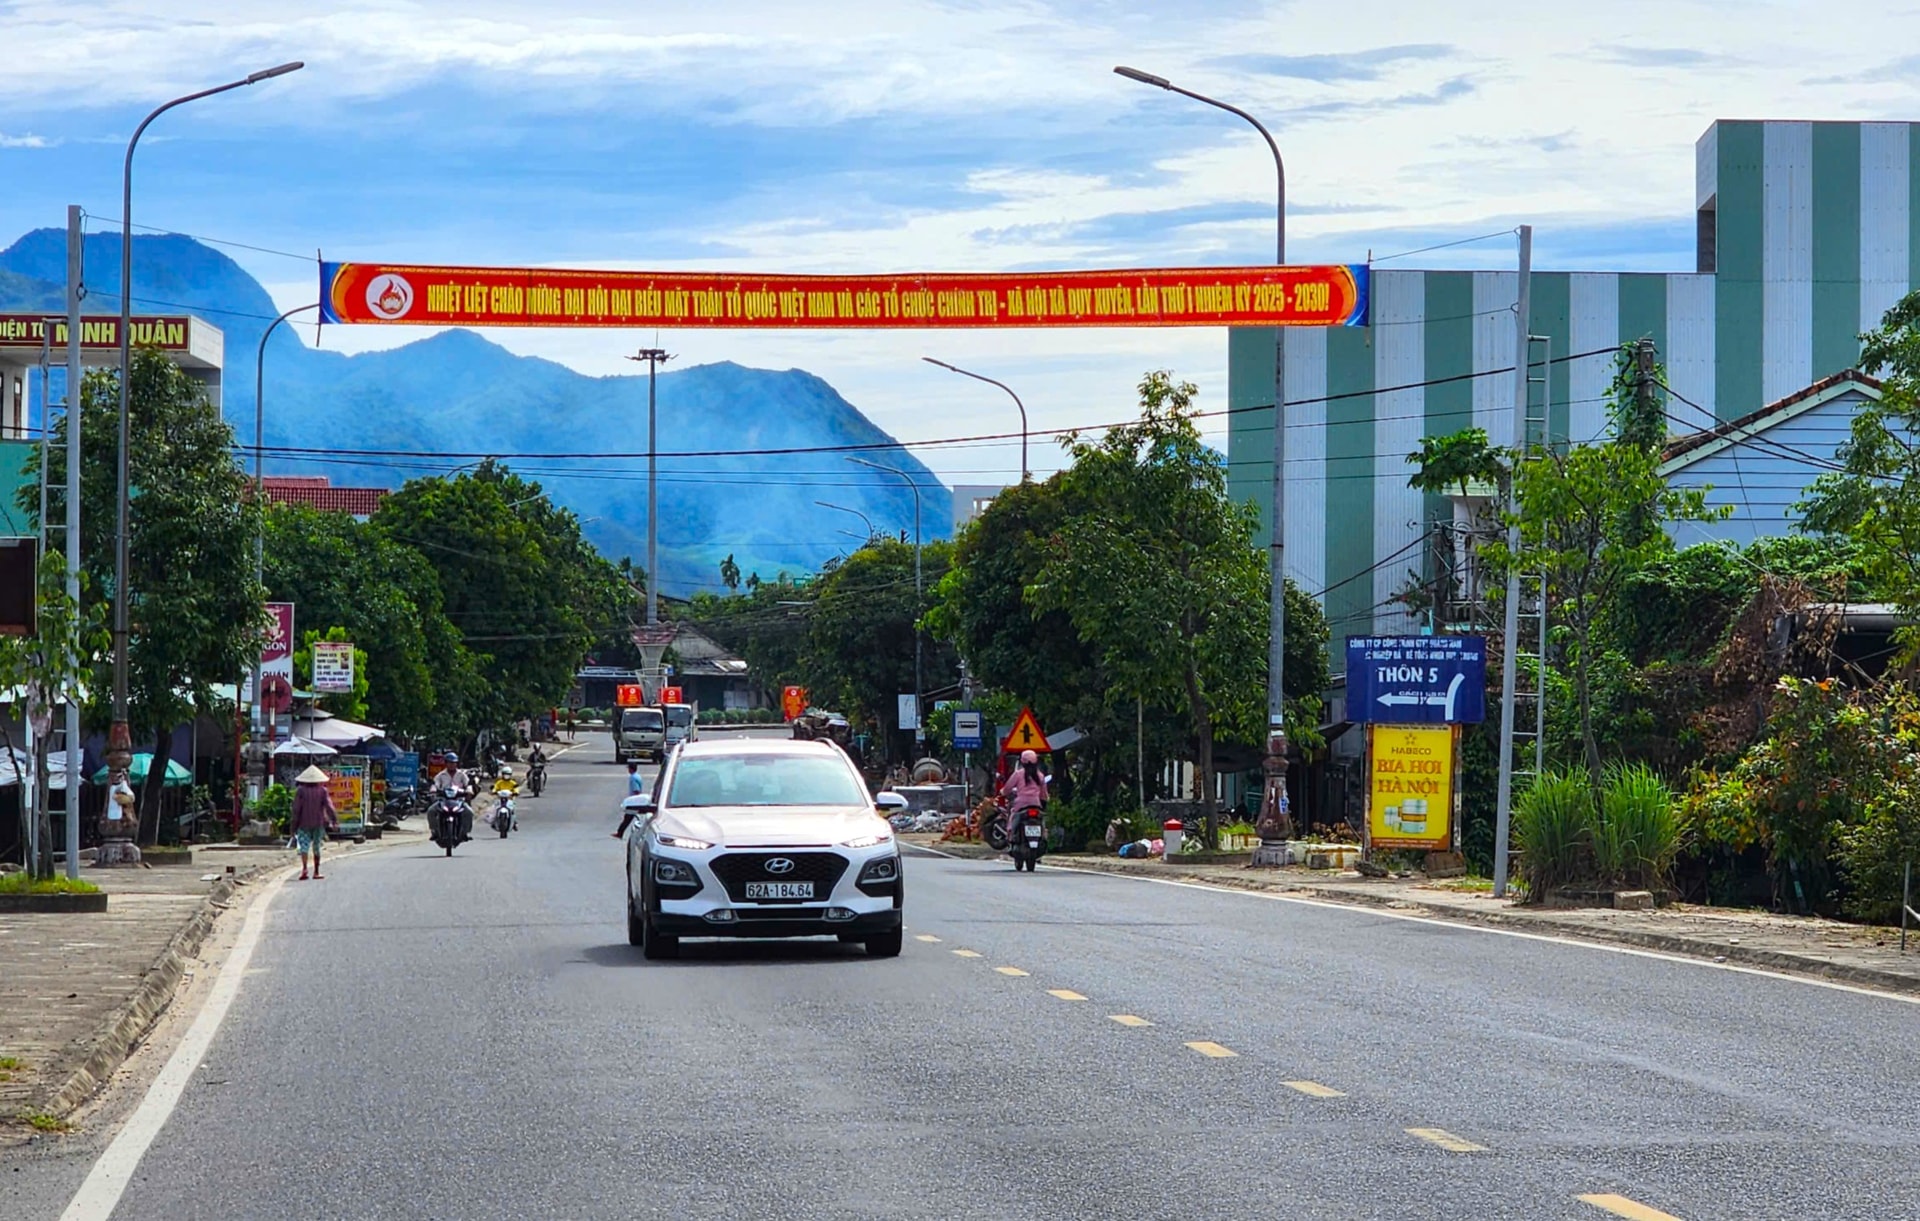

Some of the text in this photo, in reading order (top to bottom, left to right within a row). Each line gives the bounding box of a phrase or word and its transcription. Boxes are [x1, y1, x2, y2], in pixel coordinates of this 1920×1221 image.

[427, 280, 462, 318] NHIỆT
[464, 281, 489, 318] LIỆT
[491, 282, 523, 314] CHÀO
[526, 283, 561, 315] MỪNG
[564, 288, 584, 321] ĐẠI
[587, 284, 608, 321] HỘI
[611, 289, 631, 322] ĐẠI
[635, 280, 661, 316] BIỂU
[664, 286, 689, 322] MẶT
[692, 286, 723, 322] TRẬN
[725, 282, 741, 317] TỔ
[744, 282, 777, 320] QUỐC
[779, 287, 805, 322] VIỆT
[808, 291, 835, 318] NAM
[837, 288, 854, 318] VÀ
[856, 288, 880, 318] CÁC
[883, 282, 899, 317] TỔ
[901, 287, 934, 318] CHỨC
[937, 286, 975, 317] CHÍNH
[977, 290, 998, 322] TRỊ
[1007, 286, 1024, 316] XÃ
[1026, 285, 1047, 321] HỘI
[1049, 285, 1066, 315] XÃ
[1136, 278, 1158, 314] LẦN
[1160, 282, 1185, 314] THỨ
[1187, 286, 1193, 313] I
[1195, 281, 1233, 318] NHIỆM
[1235, 281, 1251, 312] KỲ
[1254, 283, 1284, 312] 2025
[1294, 283, 1329, 312] 2030!
[0, 318, 27, 340] IỆN
[1378, 664, 1439, 683] THÔN 5
[1391, 747, 1431, 755] HABECO
[1376, 759, 1406, 773] BIA
[1377, 776, 1439, 797] HÀ NỘI
[748, 884, 812, 897] 62A-184.64
